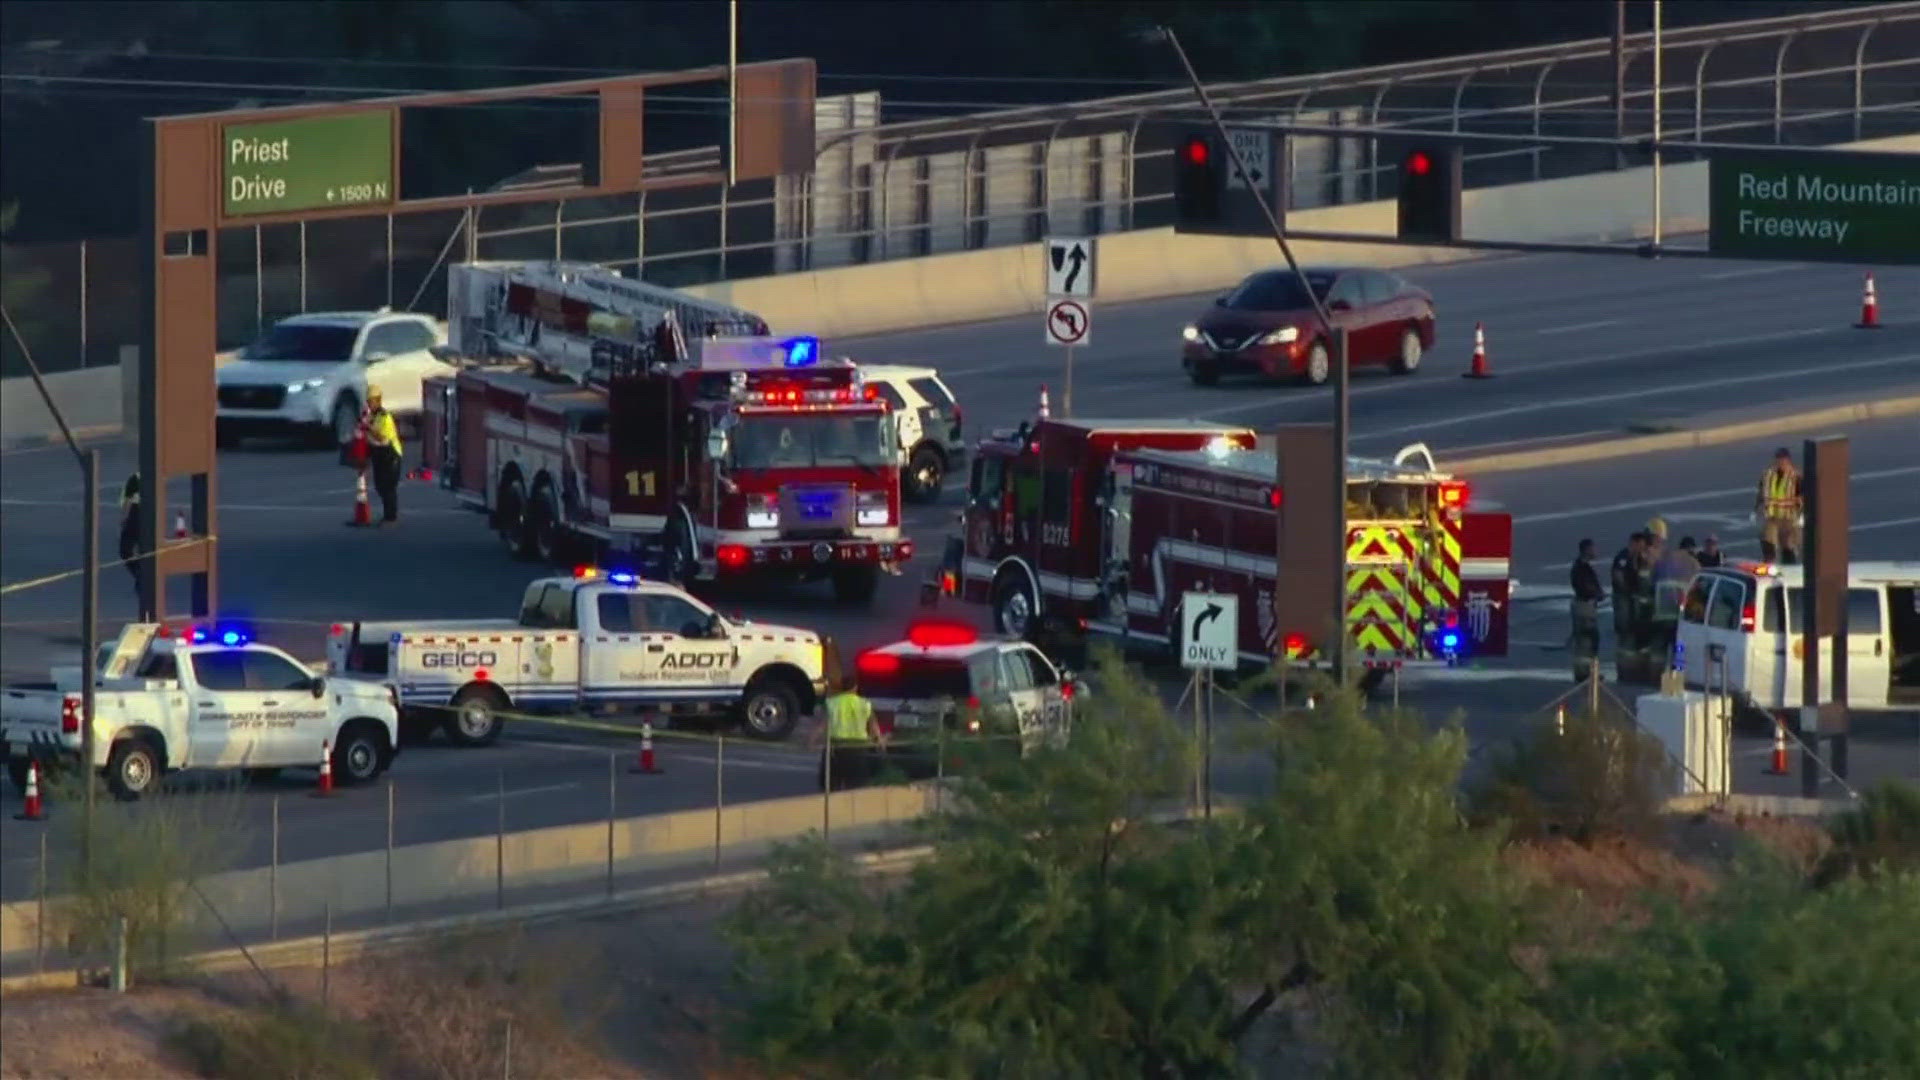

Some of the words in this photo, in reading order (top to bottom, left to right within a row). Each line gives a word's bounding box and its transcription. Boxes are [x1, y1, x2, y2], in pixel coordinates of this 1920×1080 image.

[231, 138, 289, 164] Priest
[231, 175, 286, 201] Drive
[340, 186, 372, 200] 1500
[375, 183, 387, 198] N
[1738, 173, 1788, 199] Red
[1797, 175, 1920, 204] Mountain
[1738, 209, 1849, 244] Freeway
[625, 470, 656, 496] 11
[422, 652, 497, 667] GEICO
[660, 653, 729, 668] ADOT
[1188, 646, 1226, 661] ONLY
